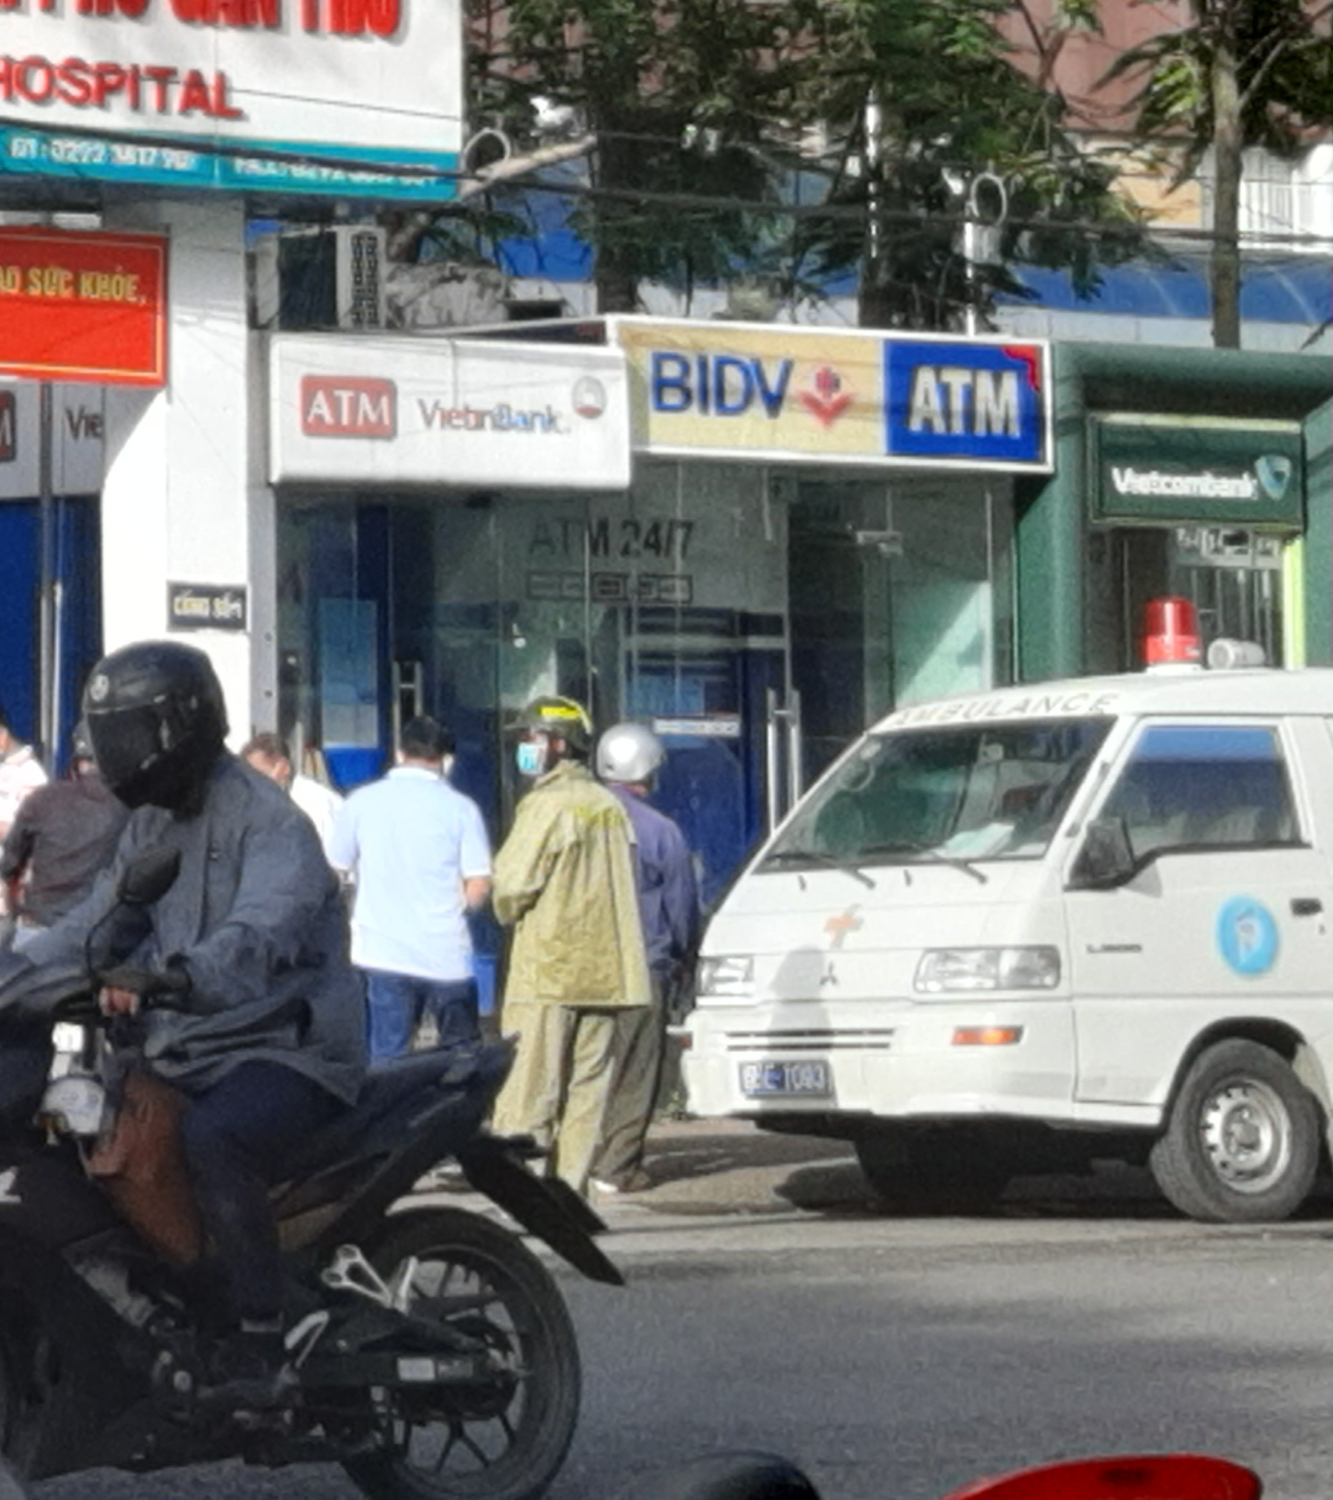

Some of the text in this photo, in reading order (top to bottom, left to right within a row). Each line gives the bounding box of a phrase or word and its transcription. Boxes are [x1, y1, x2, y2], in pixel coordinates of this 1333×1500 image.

[27, 265, 74, 297] SỨC
[651, 350, 793, 419] BIDV
[908, 365, 1021, 438] ATM
[306, 391, 390, 428] ATM
[620, 519, 694, 558] 24/7
[894, 691, 1120, 726] AMBULANCE
